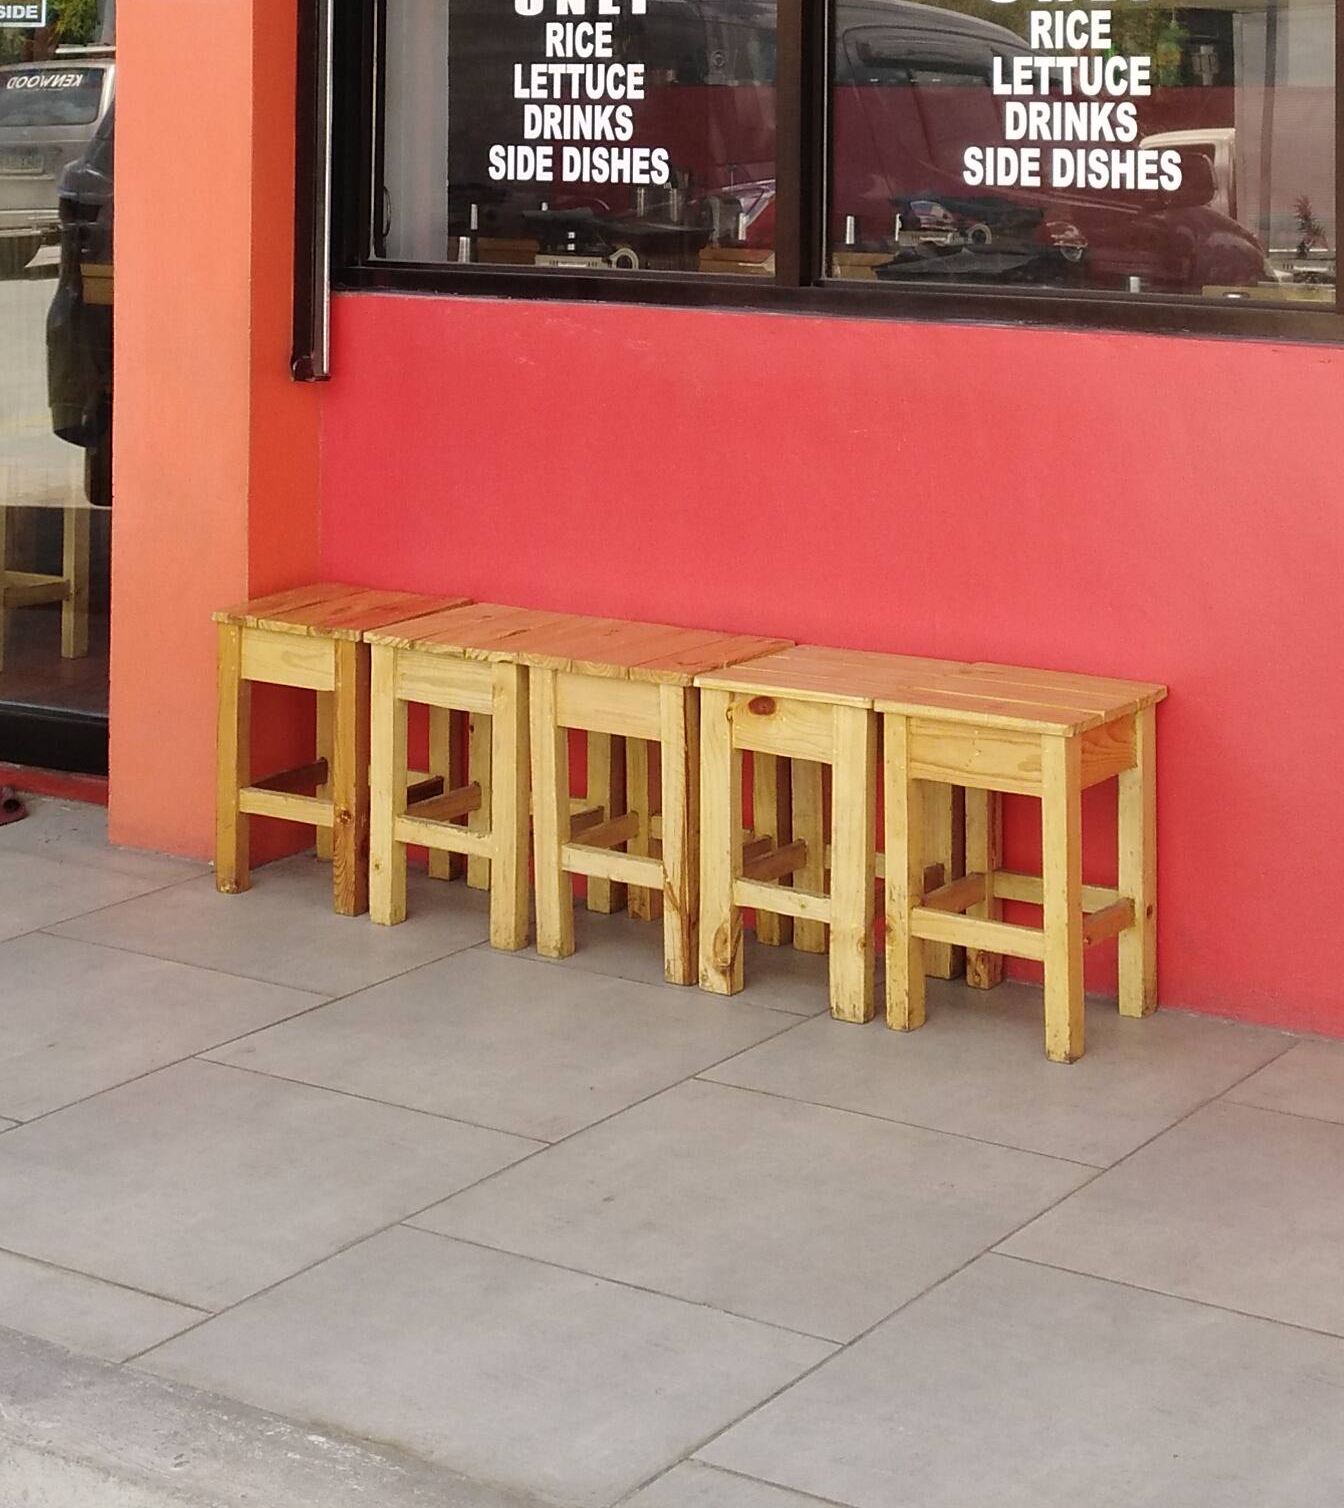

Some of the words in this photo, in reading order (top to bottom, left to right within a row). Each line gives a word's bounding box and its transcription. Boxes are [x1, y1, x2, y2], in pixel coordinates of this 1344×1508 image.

[546, 22, 613, 58] RICE
[1031, 9, 1112, 50] RICE
[514, 63, 645, 99] LETTUCE
[993, 55, 1151, 96] LETTUCE
[524, 104, 633, 141] DRINKS
[1005, 101, 1138, 142] DRINKS
[488, 145, 553, 181] SIDE
[562, 146, 669, 185] DISHES
[963, 146, 1041, 187] SIDE
[1052, 148, 1182, 191] DISHES
